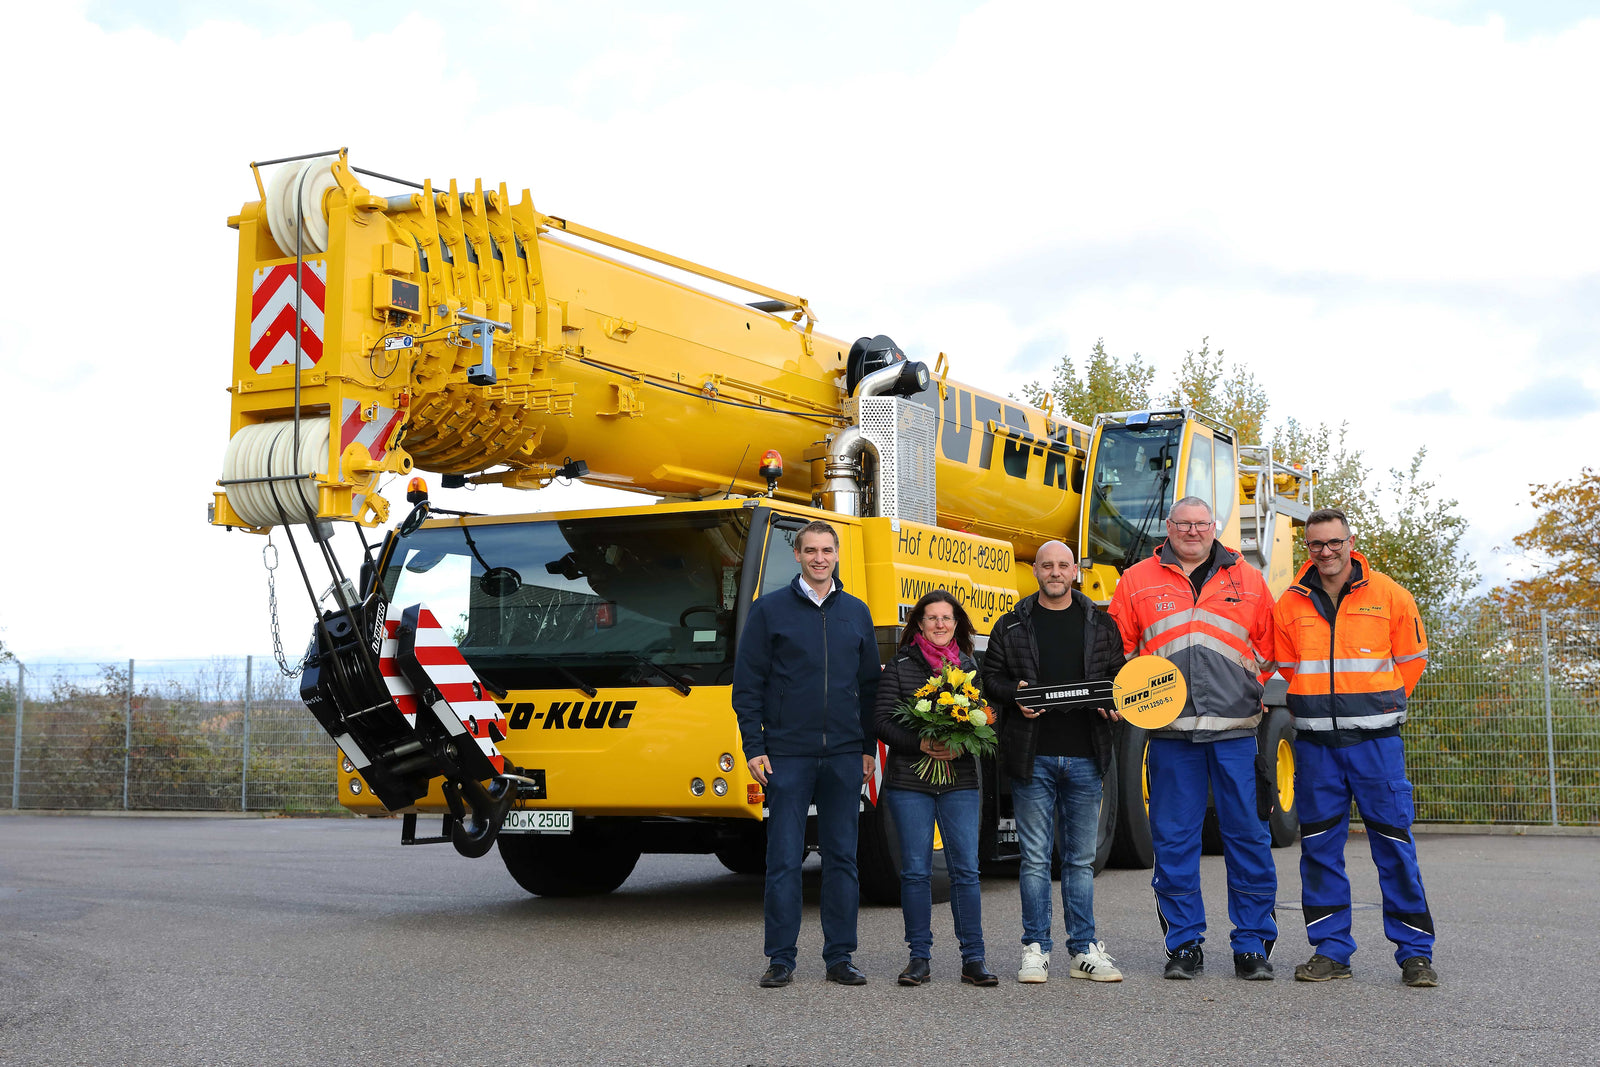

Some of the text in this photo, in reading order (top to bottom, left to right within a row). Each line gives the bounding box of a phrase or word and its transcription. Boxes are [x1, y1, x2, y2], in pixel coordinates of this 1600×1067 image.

[898, 527, 1011, 573] Hof 09281-62980
[1045, 688, 1090, 700] LIEBHERR
[1124, 690, 1149, 706] AUTO
[1151, 673, 1174, 688] KLUG
[1137, 705, 1150, 713] LTM
[503, 813, 570, 828] HO K 2500
